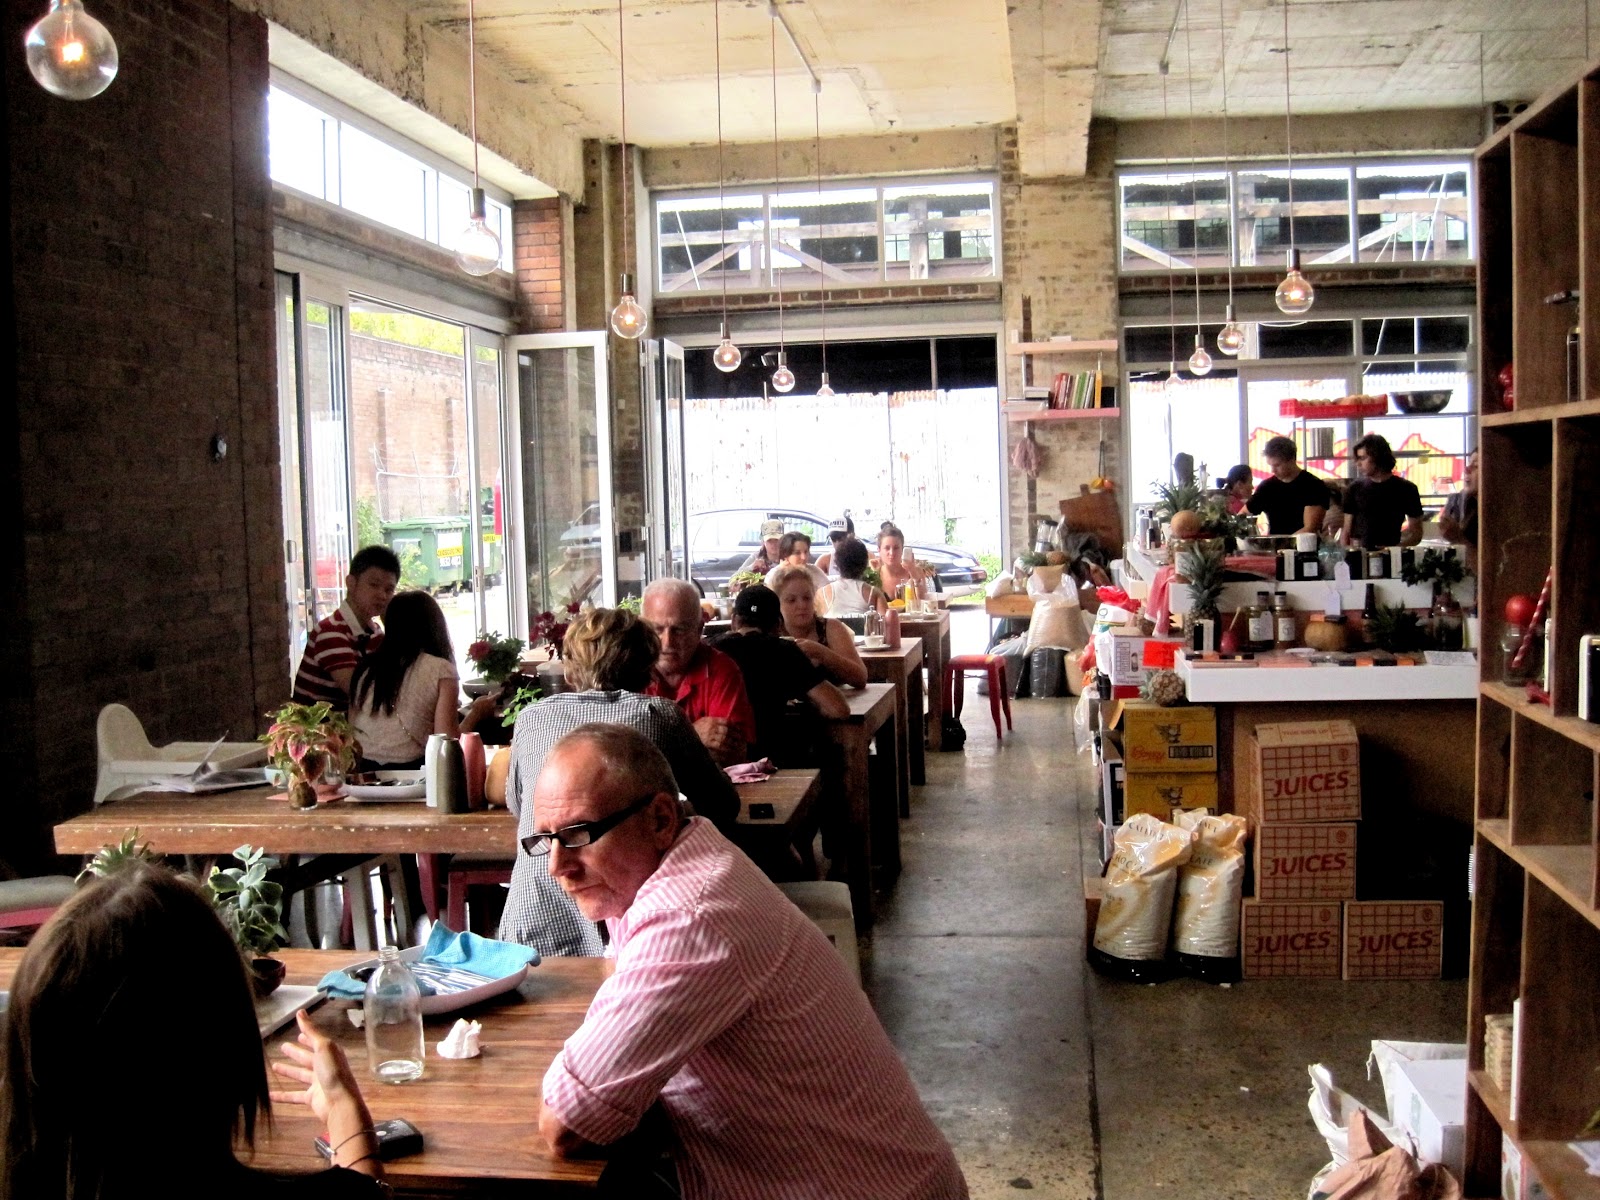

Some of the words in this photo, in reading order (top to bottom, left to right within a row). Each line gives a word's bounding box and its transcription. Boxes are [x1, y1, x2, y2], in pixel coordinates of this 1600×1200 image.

[1274, 770, 1349, 797] JUICES
[1271, 853, 1346, 876] JUICES
[1255, 930, 1330, 953] JUICES
[1357, 930, 1433, 954] JUICES
